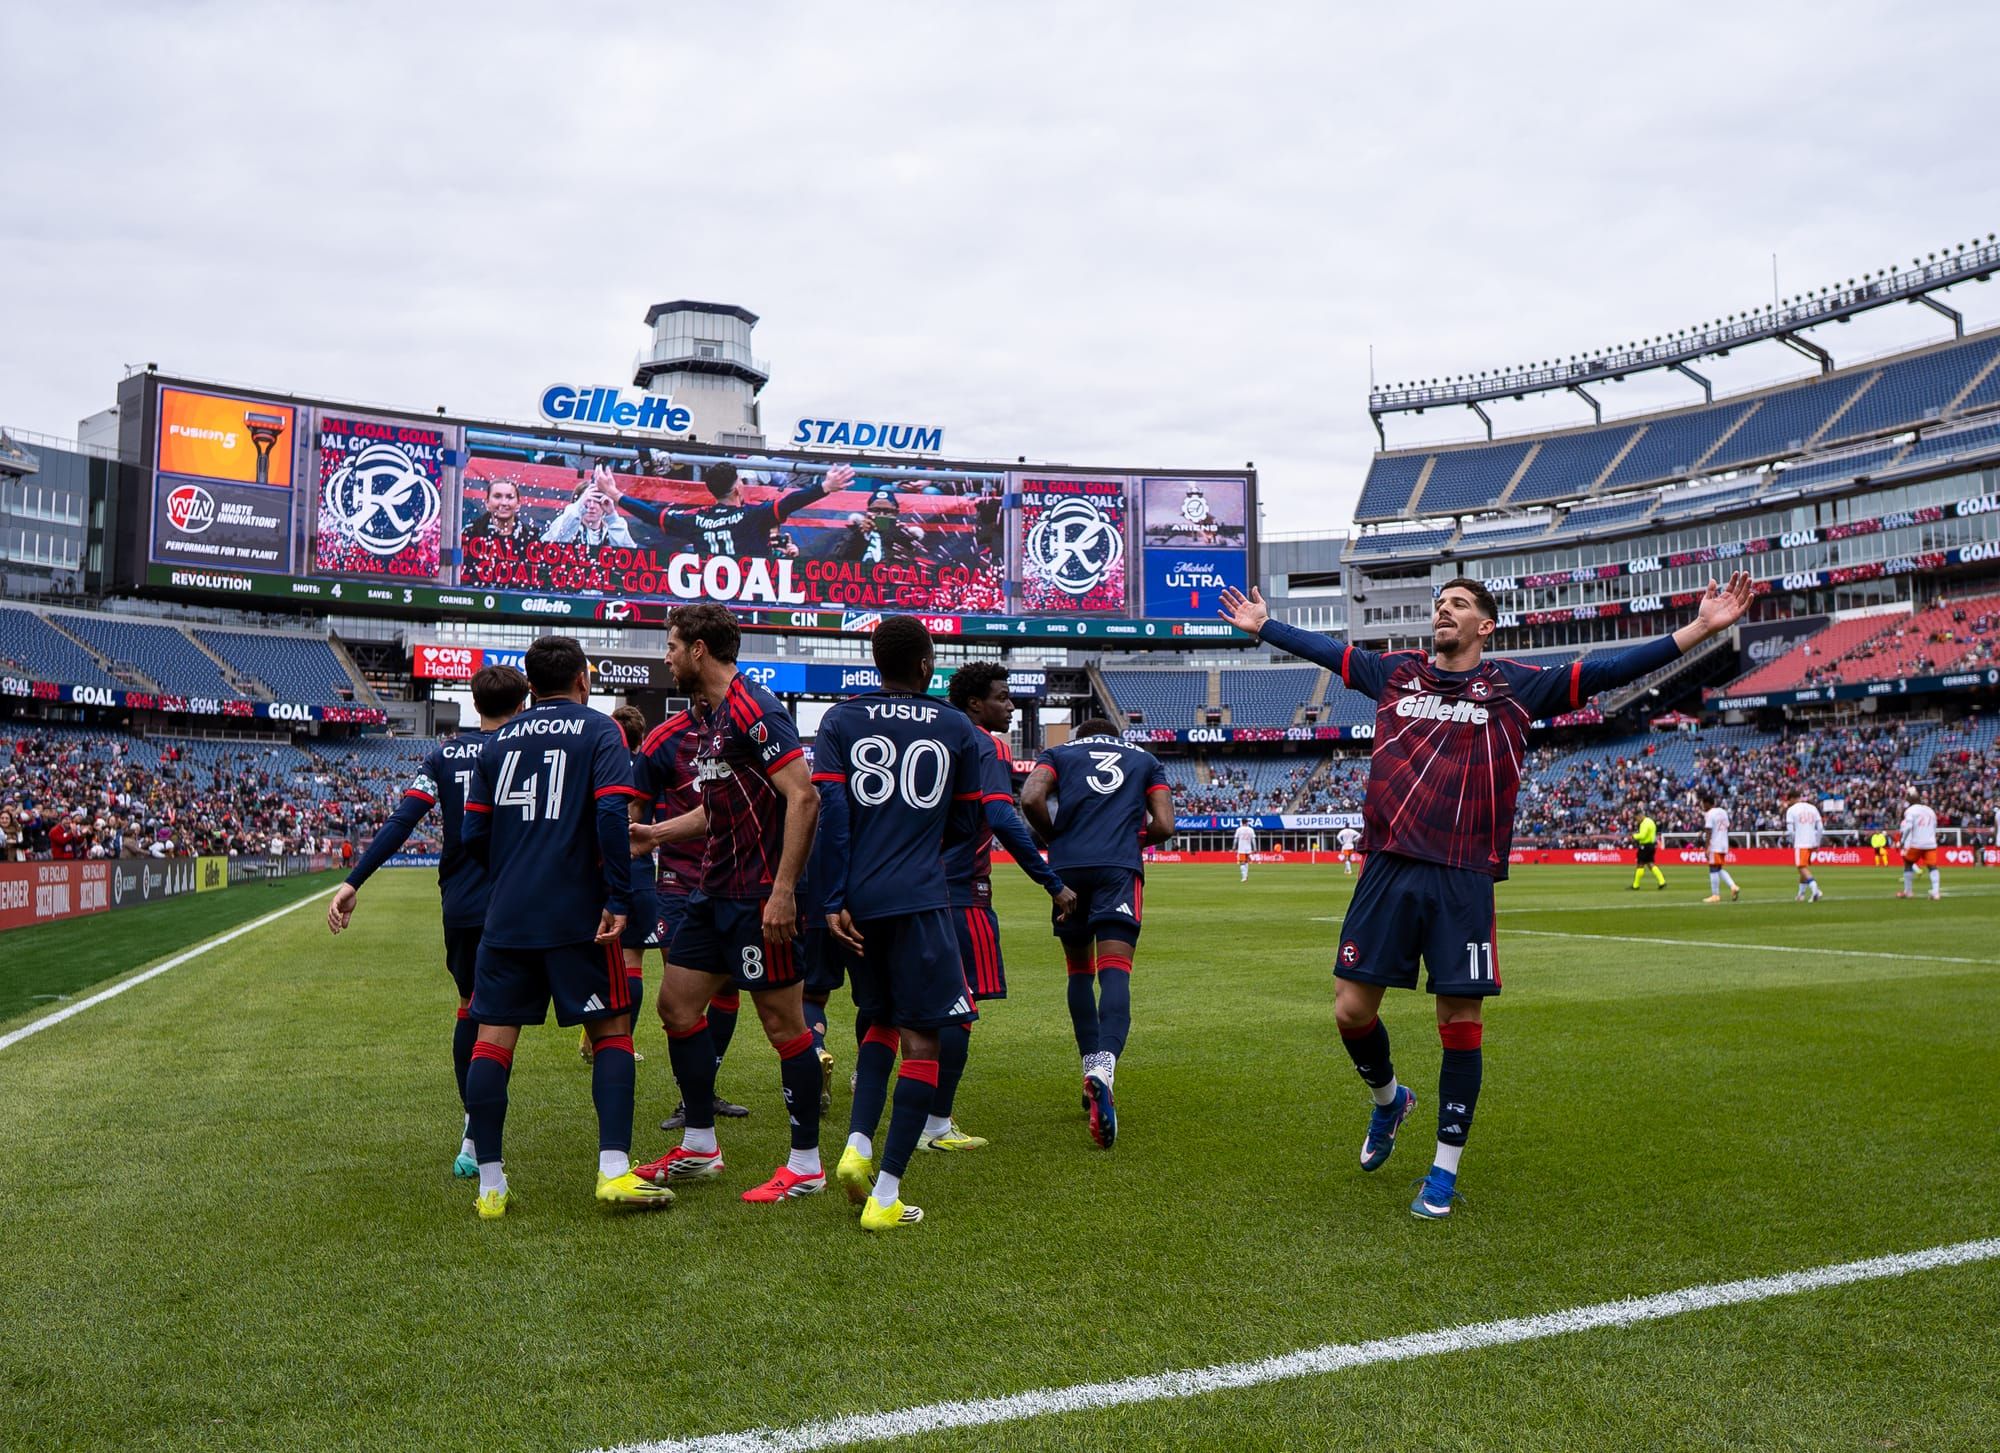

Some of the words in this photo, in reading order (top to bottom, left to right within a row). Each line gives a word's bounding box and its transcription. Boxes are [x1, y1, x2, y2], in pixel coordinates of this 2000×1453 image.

[542, 387, 691, 432] Gillette
[321, 434, 345, 449] AL
[354, 422, 394, 440] GOAL
[398, 427, 438, 446] GOAL
[795, 419, 943, 452] STADIUM
[1049, 482, 1082, 493] GOAL
[1085, 483, 1118, 494] GOAL
[1022, 494, 1041, 505] AL
[1956, 492, 2000, 517] GOAL
[221, 502, 253, 515] WASTE
[217, 513, 277, 528] INNOVATIONS
[1172, 524, 1218, 532] ARIENS
[704, 530, 735, 555] 11
[1780, 530, 1819, 548] GOAL
[165, 541, 219, 555] PERFORMANCE
[220, 546, 235, 556] FOR
[236, 548, 250, 557] THE
[250, 549, 278, 560] PLANET
[526, 541, 592, 566] GOAL
[600, 546, 667, 571] GOAL
[1959, 541, 2000, 563] GOAL
[388, 560, 428, 577] GOAL
[806, 560, 866, 583] GOAL
[872, 562, 933, 586] GOAL
[1173, 562, 1215, 573] Michelob
[1629, 556, 1662, 574] GOAL
[172, 572, 252, 591] REVOLUTION
[477, 560, 545, 586] GOAL
[551, 566, 616, 591] GOAL
[623, 571, 673, 594] GOA
[667, 552, 805, 604] GOAL
[1166, 574, 1225, 587] ULTRA
[1484, 577, 1518, 592] GOAL
[1783, 572, 1821, 590] GOAL
[293, 583, 320, 594] SHOTS:
[331, 583, 342, 597] 4
[368, 589, 392, 599] SAVES:
[403, 589, 412, 603] 3
[828, 583, 886, 605] GOAL
[439, 595, 474, 606] CORNERS:
[484, 595, 495, 609] 0
[521, 598, 571, 614] Gillette
[1630, 598, 1664, 613] GOAL
[791, 612, 818, 627] CIN
[1017, 621, 1026, 633] 4
[1496, 614, 1519, 628] OAL
[1077, 622, 1087, 634] 0
[1145, 624, 1155, 635] 0
[1172, 625, 1183, 635] FC
[1184, 623, 1232, 635] CINCINNATI
[439, 648, 472, 664] CVS
[600, 676, 649, 684] INSURANCE
[841, 670, 882, 689] jetBlu
[1006, 674, 1046, 685] RENZO
[1988, 669, 1998, 683] 0
[1008, 686, 1036, 694] PANIES
[1899, 680, 1907, 693] 3
[72, 685, 116, 706] GOAL
[1718, 696, 1767, 710] REVOLUTION
[1827, 686, 1836, 699] 4
[268, 703, 313, 720] GOAL
[865, 703, 939, 724] YUSUF
[1396, 695, 1489, 725] Gillette
[498, 719, 585, 742] LANGONI
[1188, 729, 1226, 742] GOAL
[850, 735, 950, 809] 80
[1086, 751, 1124, 794] 3
[495, 749, 567, 822] 41
[1296, 816, 1349, 826] SUPERIOR
[418, 858, 440, 868] Brigha
[1581, 852, 1597, 862] CVS
[1816, 851, 1833, 863] CV
[1832, 852, 1860, 863] ealth
[742, 944, 764, 981] 8
[1467, 943, 1493, 980] 11
